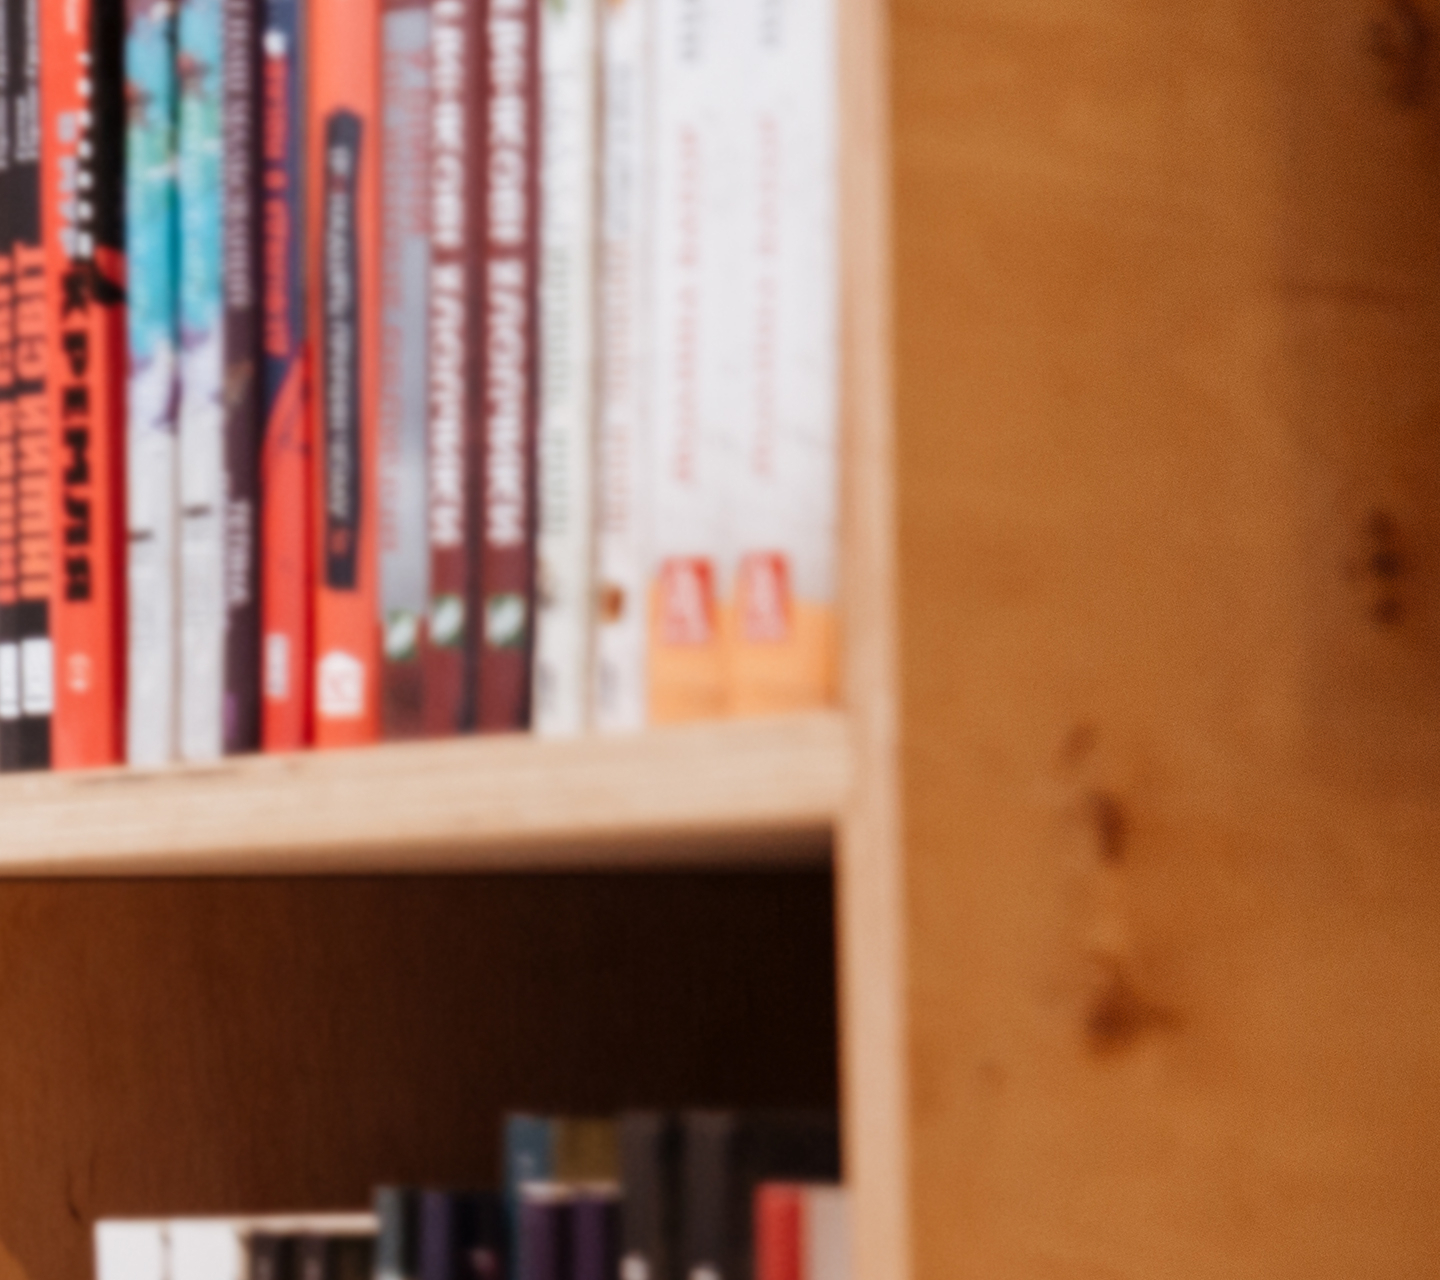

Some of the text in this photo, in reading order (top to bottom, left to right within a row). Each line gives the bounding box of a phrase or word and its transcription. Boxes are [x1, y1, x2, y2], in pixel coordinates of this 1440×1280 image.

[12, 241, 49, 601] ІНШИЙ СВІТ
[59, 265, 93, 604] КРЕМЛЯ
